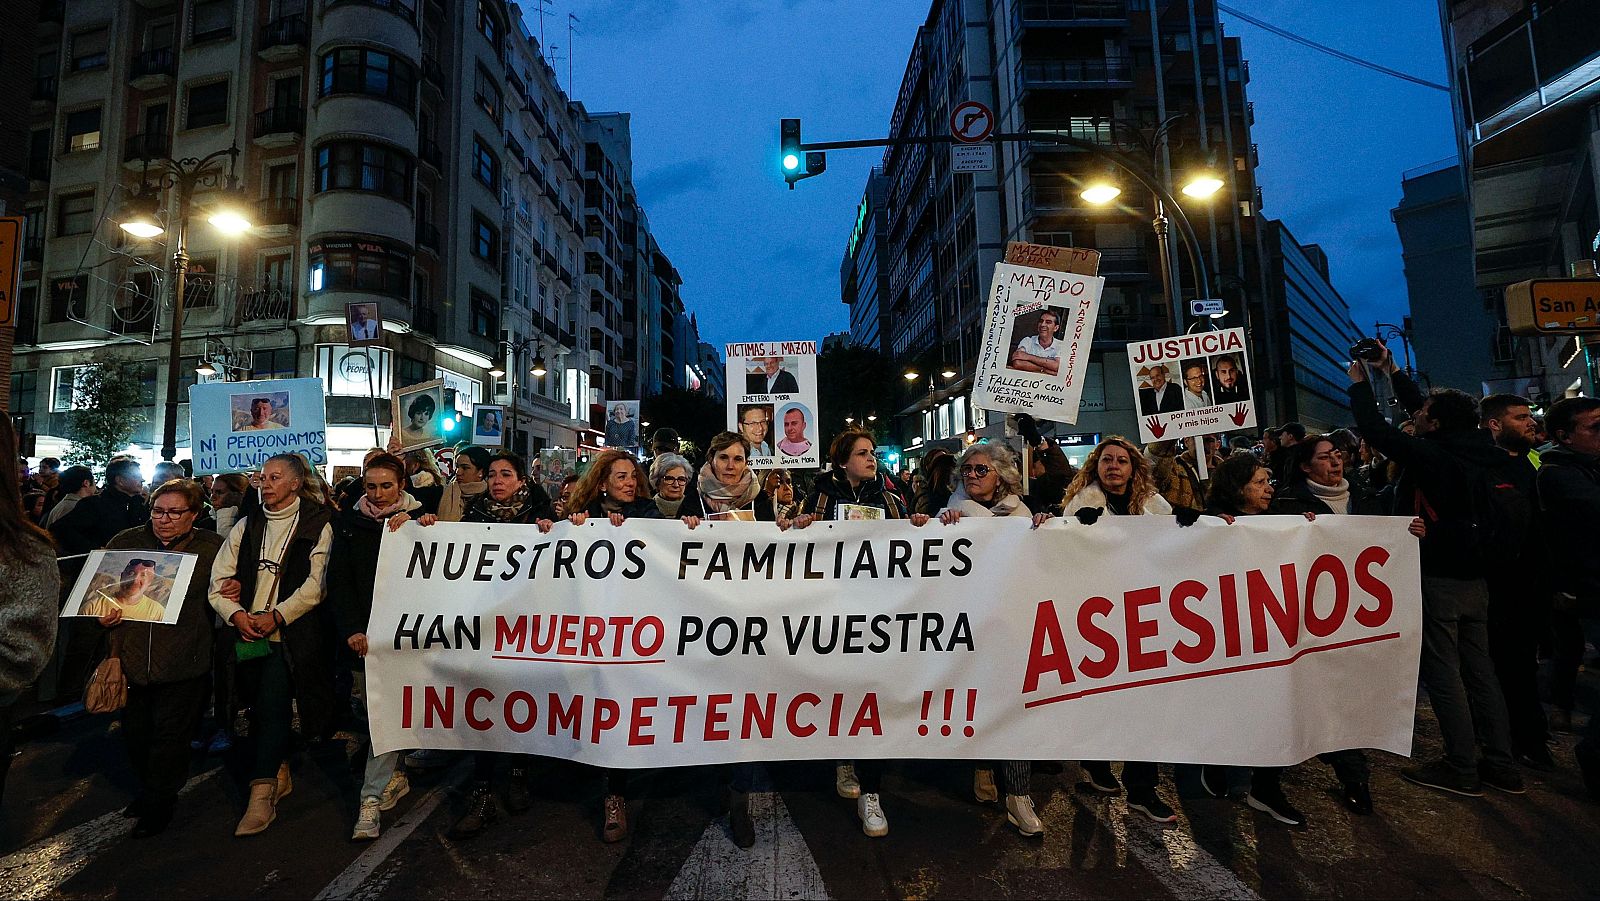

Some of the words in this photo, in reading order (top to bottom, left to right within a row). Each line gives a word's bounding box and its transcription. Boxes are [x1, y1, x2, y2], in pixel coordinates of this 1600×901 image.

[1010, 273, 1085, 297] MATADO
[1539, 297, 1576, 313] San
[1584, 296, 1600, 313] A
[726, 342, 766, 358] VICTIMAS
[1133, 331, 1243, 364] JUSTICIA
[989, 374, 1043, 390] FALLECIÓ
[1044, 383, 1065, 393] CON
[986, 385, 1032, 400] NUESTROS
[1033, 393, 1066, 406] AMADOS
[1170, 413, 1184, 422] por
[1186, 410, 1196, 418] mi
[1197, 405, 1224, 416] marido
[1178, 422, 1183, 430] y
[1184, 419, 1199, 428] mis
[1200, 416, 1219, 426] hijos
[227, 431, 325, 450] PERDONAMOS
[406, 539, 647, 582] NUESTROS
[678, 538, 973, 580] FAMILIARES
[1021, 545, 1394, 695] ASESINOS
[394, 613, 481, 651] HAN
[494, 614, 665, 658] MUERTO
[677, 615, 768, 657] POR
[782, 612, 975, 656] VUESTRA
[402, 685, 883, 747] INCOMPETENCIA
[917, 688, 978, 738] !!!
